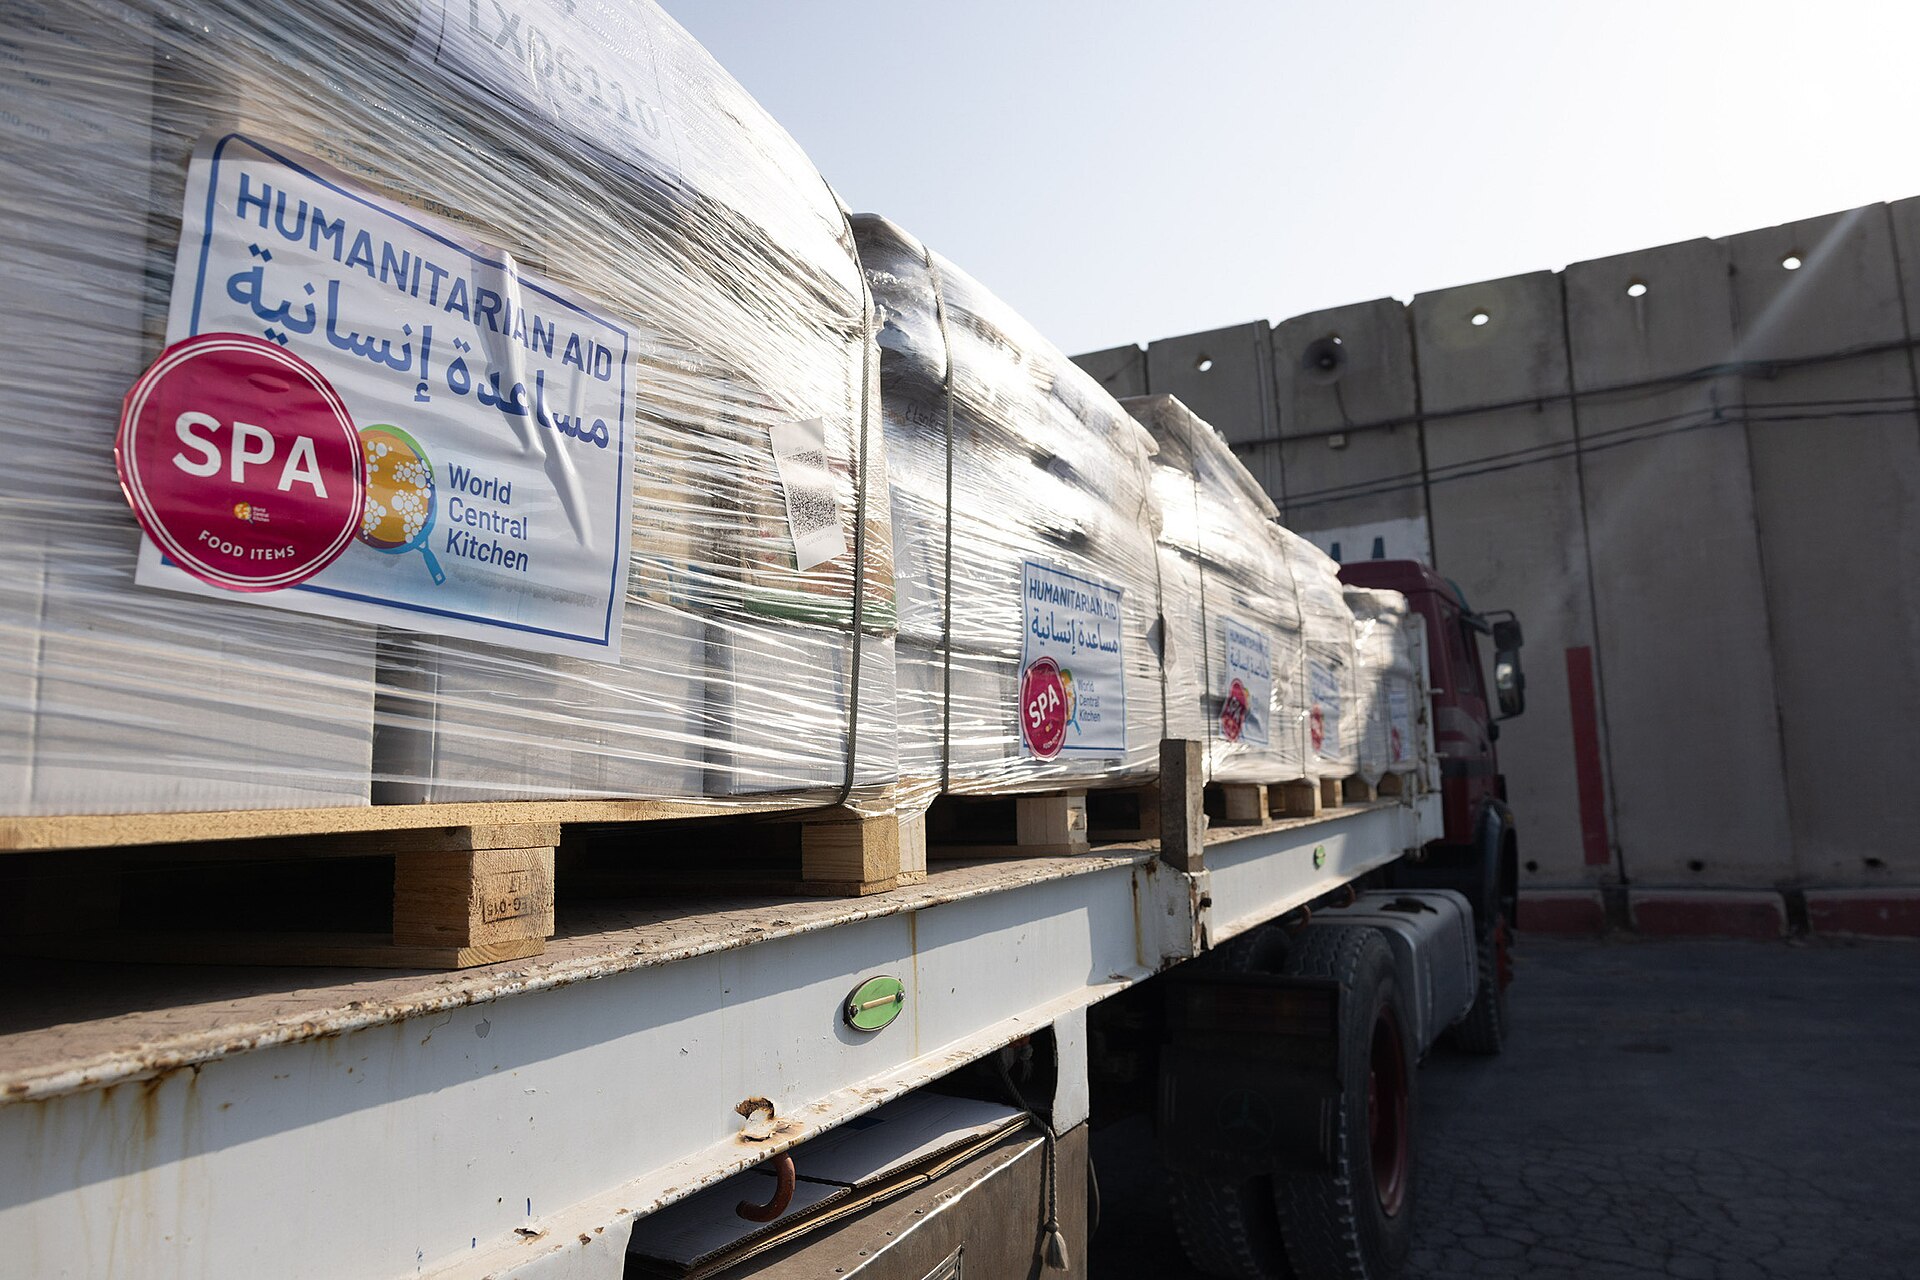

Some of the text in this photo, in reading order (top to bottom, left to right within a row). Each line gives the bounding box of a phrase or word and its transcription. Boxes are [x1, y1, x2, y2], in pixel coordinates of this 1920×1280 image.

[237, 172, 613, 382] HUMANITARIAN AID
[226, 243, 610, 449] مساعدة إنسانية
[172, 411, 329, 499] SPA
[448, 462, 512, 505] World
[449, 496, 528, 541] Central
[198, 529, 296, 560] FOOD ITEMS
[445, 528, 529, 572] Kitchen
[1029, 578, 1117, 620] HUMANITARIAN AID
[1032, 607, 1118, 656] مساعدة إنسانية
[1029, 684, 1060, 729] SPA
